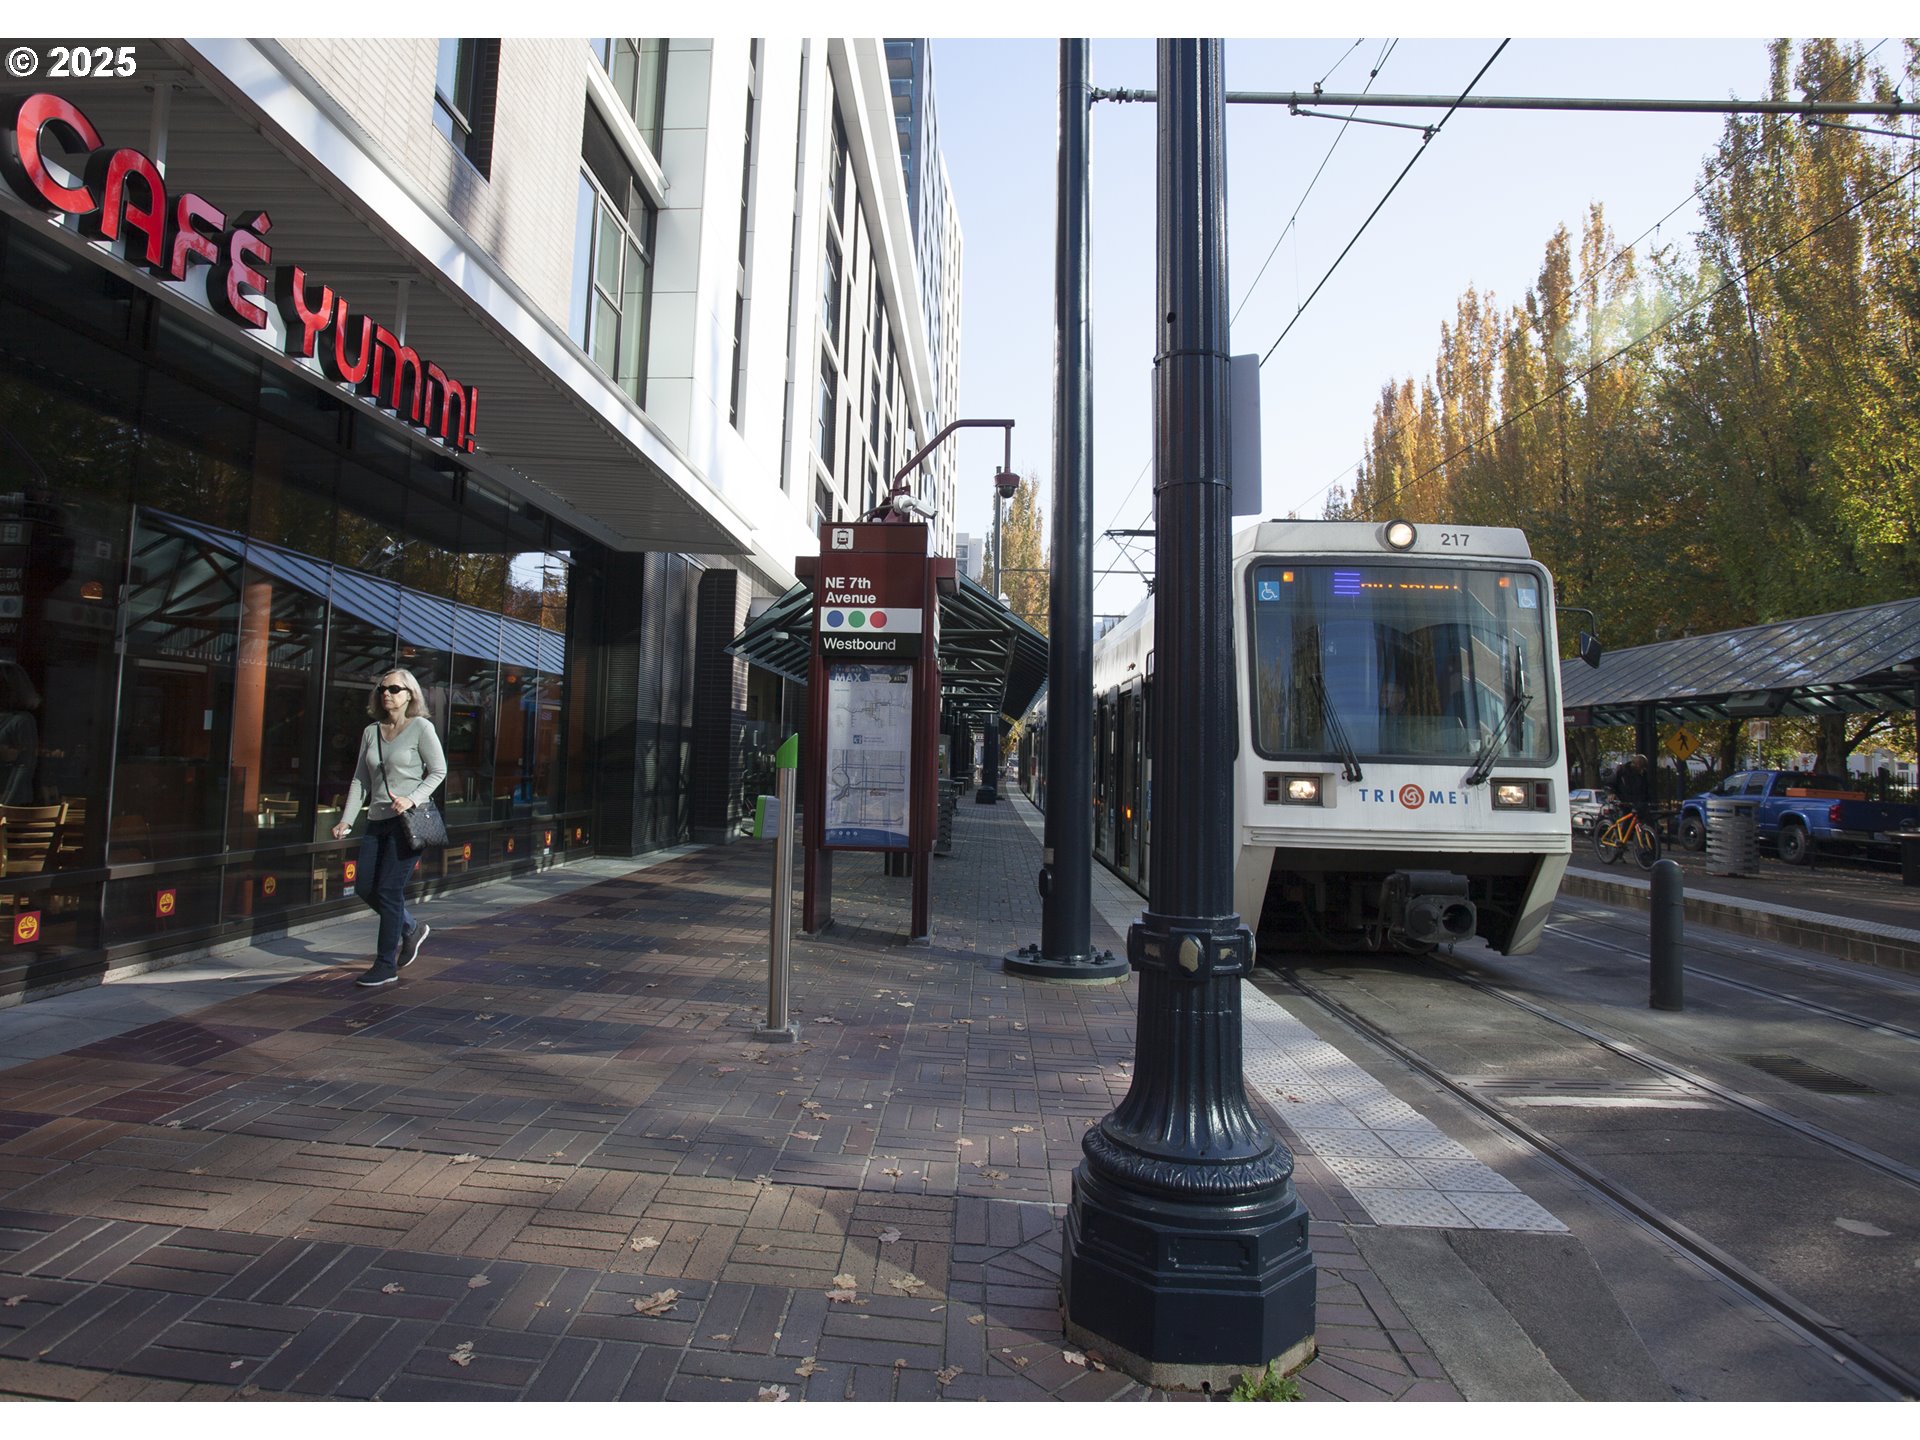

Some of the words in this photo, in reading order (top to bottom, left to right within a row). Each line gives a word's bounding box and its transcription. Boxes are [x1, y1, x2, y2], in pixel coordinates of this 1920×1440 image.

[10, 92, 274, 330] CAFÉ
[1441, 533, 1470, 547] 217
[825, 577, 845, 589] NE
[849, 577, 871, 589] 7th
[825, 592, 877, 604] Avenue
[823, 637, 896, 651] Westbound
[834, 672, 862, 683] MAX
[1359, 788, 1395, 803] TRI
[1429, 790, 1471, 805] MET
